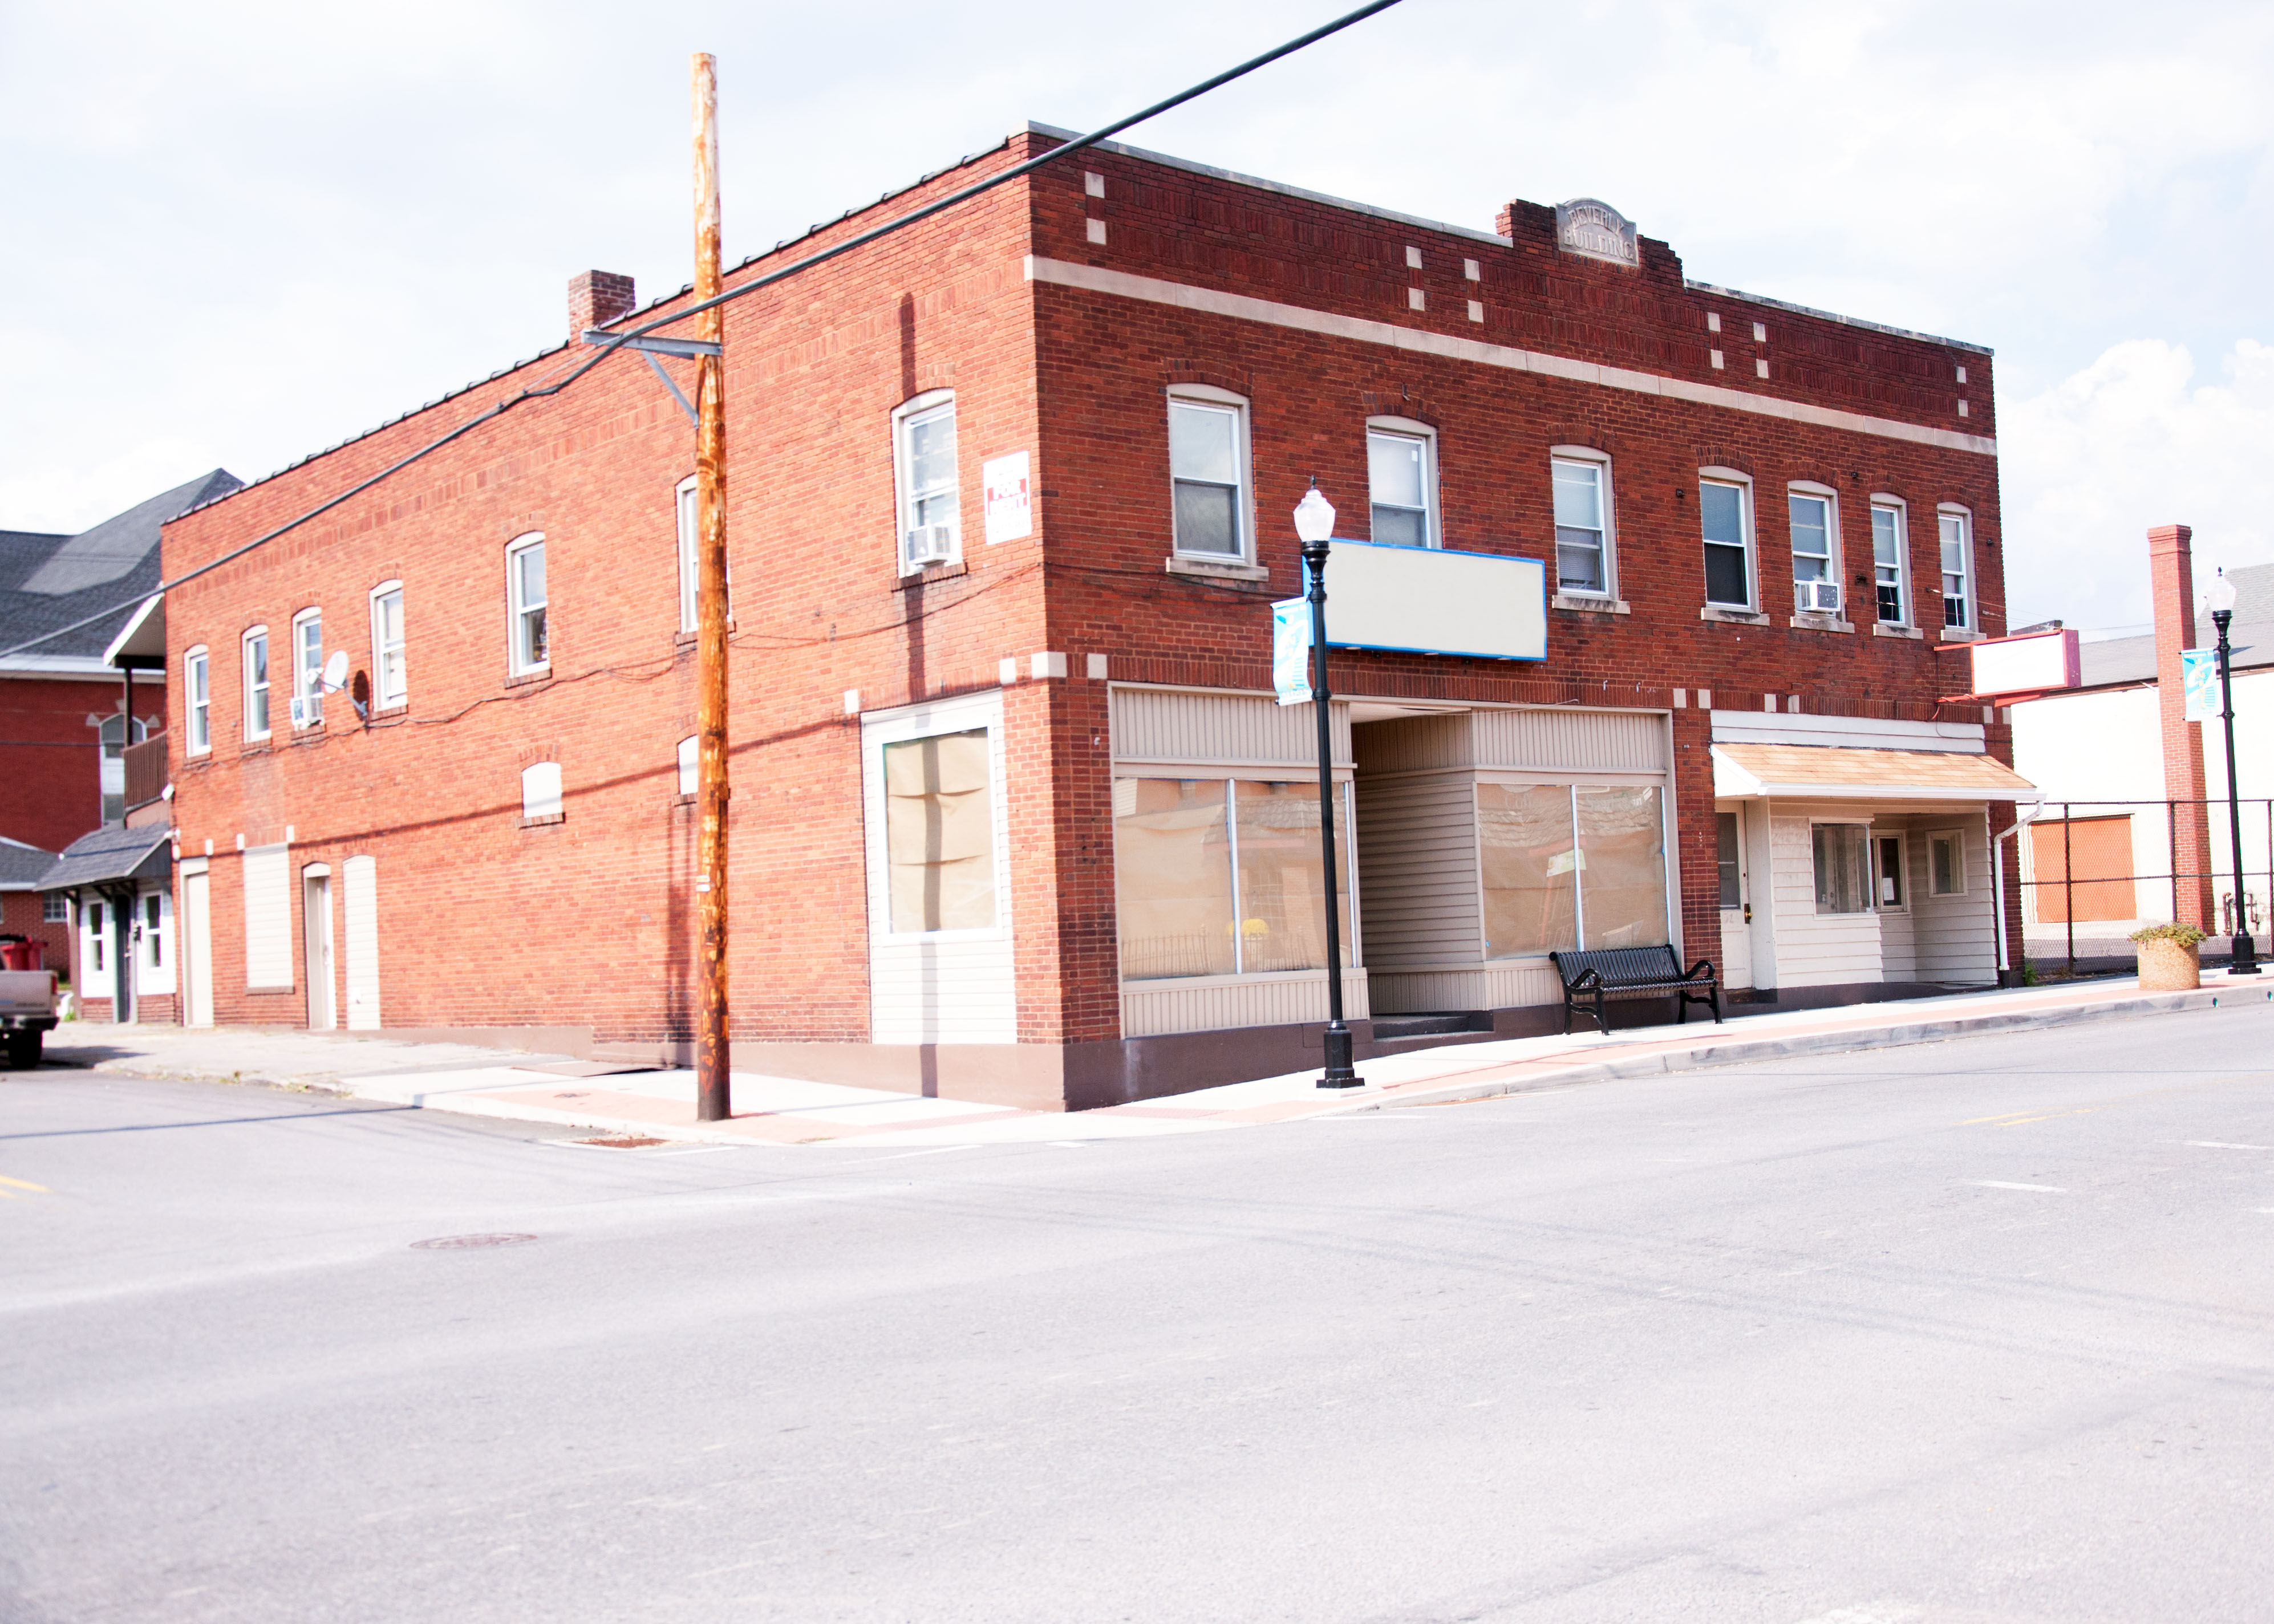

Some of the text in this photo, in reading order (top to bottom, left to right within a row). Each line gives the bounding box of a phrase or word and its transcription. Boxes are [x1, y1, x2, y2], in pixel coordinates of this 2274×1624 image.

[1568, 206, 1624, 236] BEVERLY
[1564, 228, 1634, 259] BUILDING
[992, 480, 1021, 501] FOR
